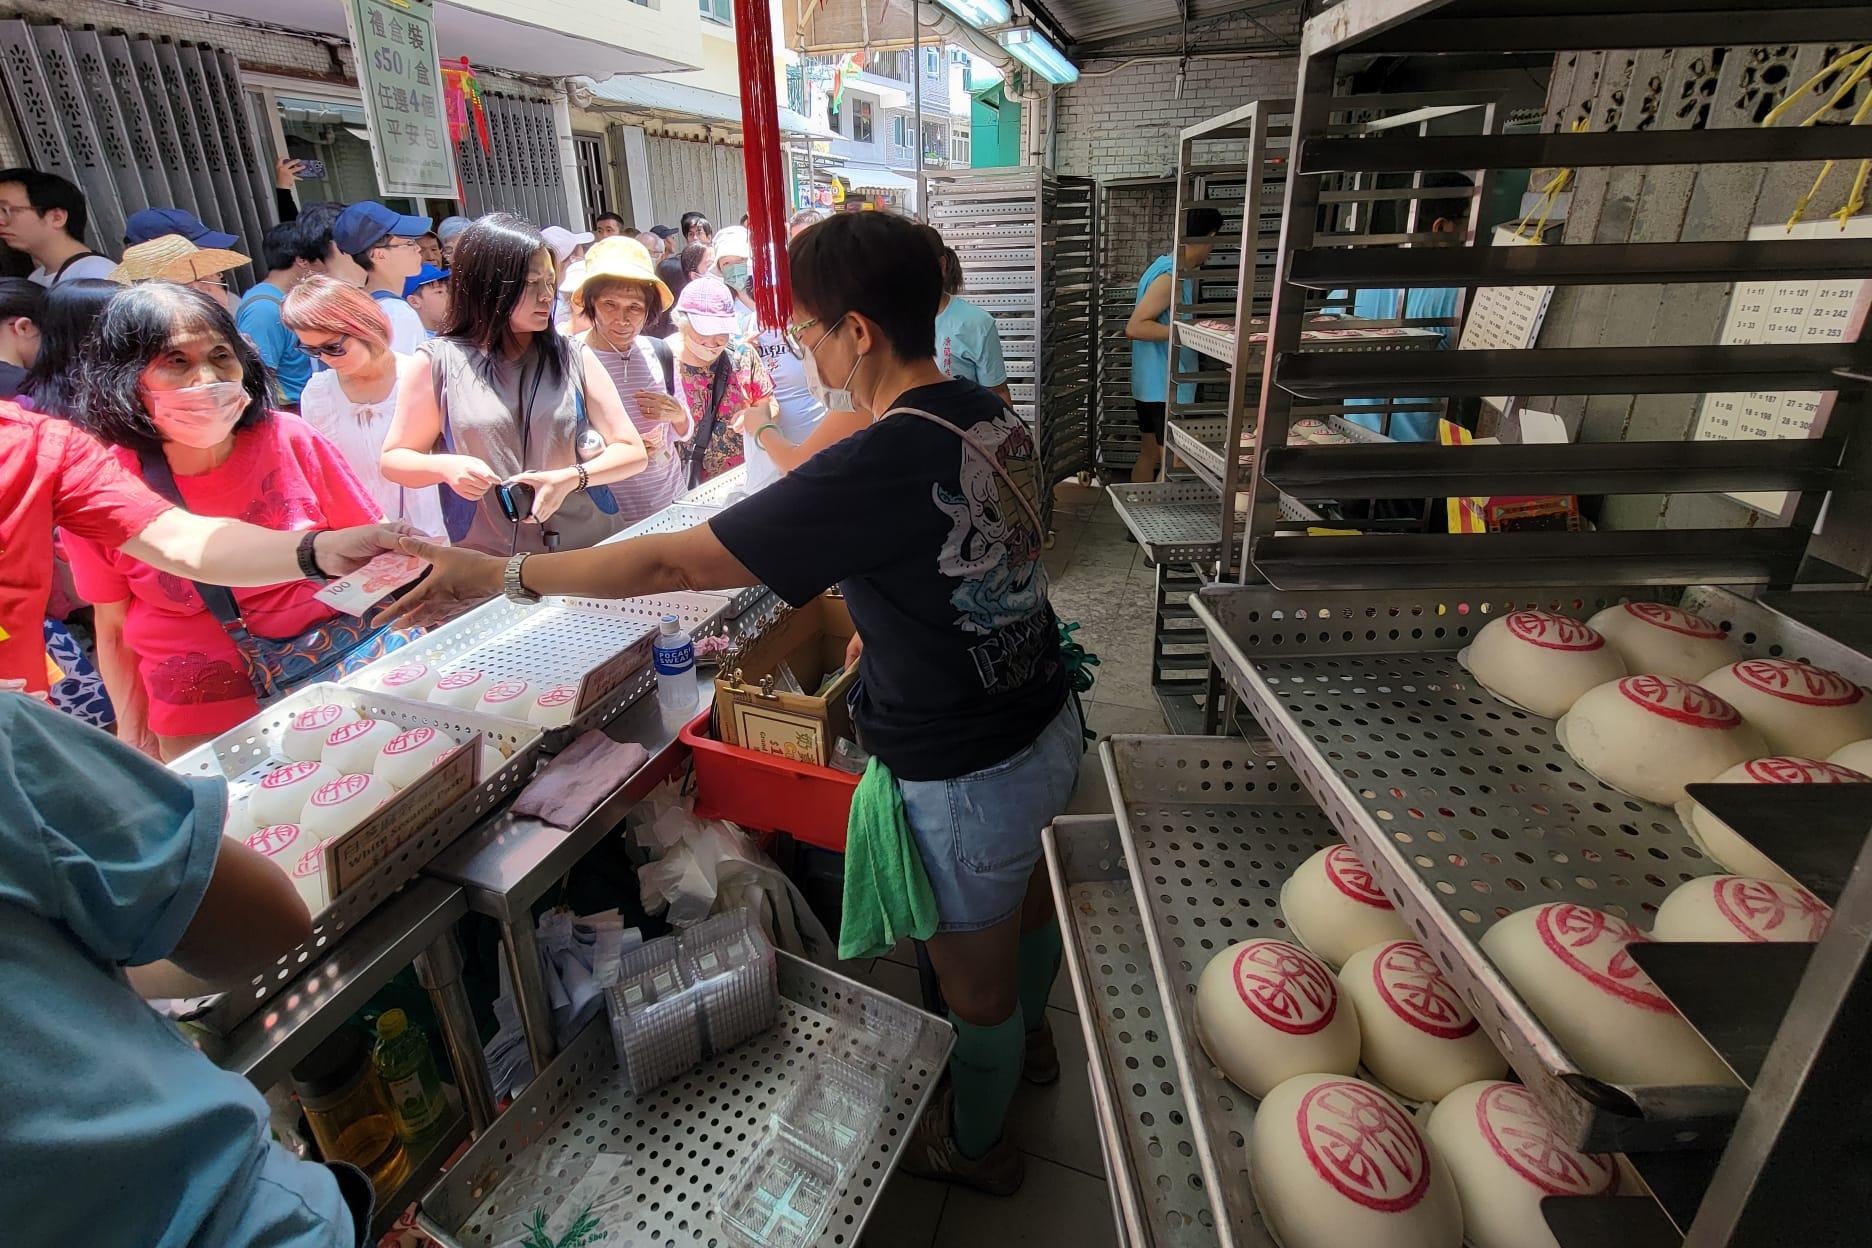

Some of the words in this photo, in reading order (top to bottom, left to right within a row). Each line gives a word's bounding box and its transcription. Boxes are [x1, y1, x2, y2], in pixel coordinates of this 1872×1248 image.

[368, 6, 425, 51] 禮盒裝
[378, 82, 436, 118] 任選4個
[386, 119, 438, 149] 平安包
[1796, 289, 1809, 297] 121
[1820, 290, 1829, 298] 21
[1838, 290, 1853, 298] 231
[1751, 305, 1760, 313] 22
[1772, 306, 1781, 314] 12
[1790, 307, 1803, 315] 132
[1813, 309, 1823, 317] 22
[1832, 309, 1848, 318] 242
[1784, 324, 1797, 333] 143
[1807, 327, 1817, 335] 23
[1826, 328, 1842, 337] 253
[1765, 394, 1777, 403] 187
[1725, 403, 1733, 411] 88
[1786, 399, 1796, 408] 27
[1804, 402, 1820, 412] 297
[1745, 408, 1753, 416] 18
[1760, 411, 1772, 421] 198
[1721, 418, 1729, 426] 99
[1781, 416, 1791, 425] 28
[1741, 424, 1748, 432] 19
[1755, 428, 1767, 438] 209
[326, 581, 351, 595] 100
[660, 654, 689, 664] SWEAT
[349, 836, 387, 867] White
[588, 1230, 608, 1243] Shop
